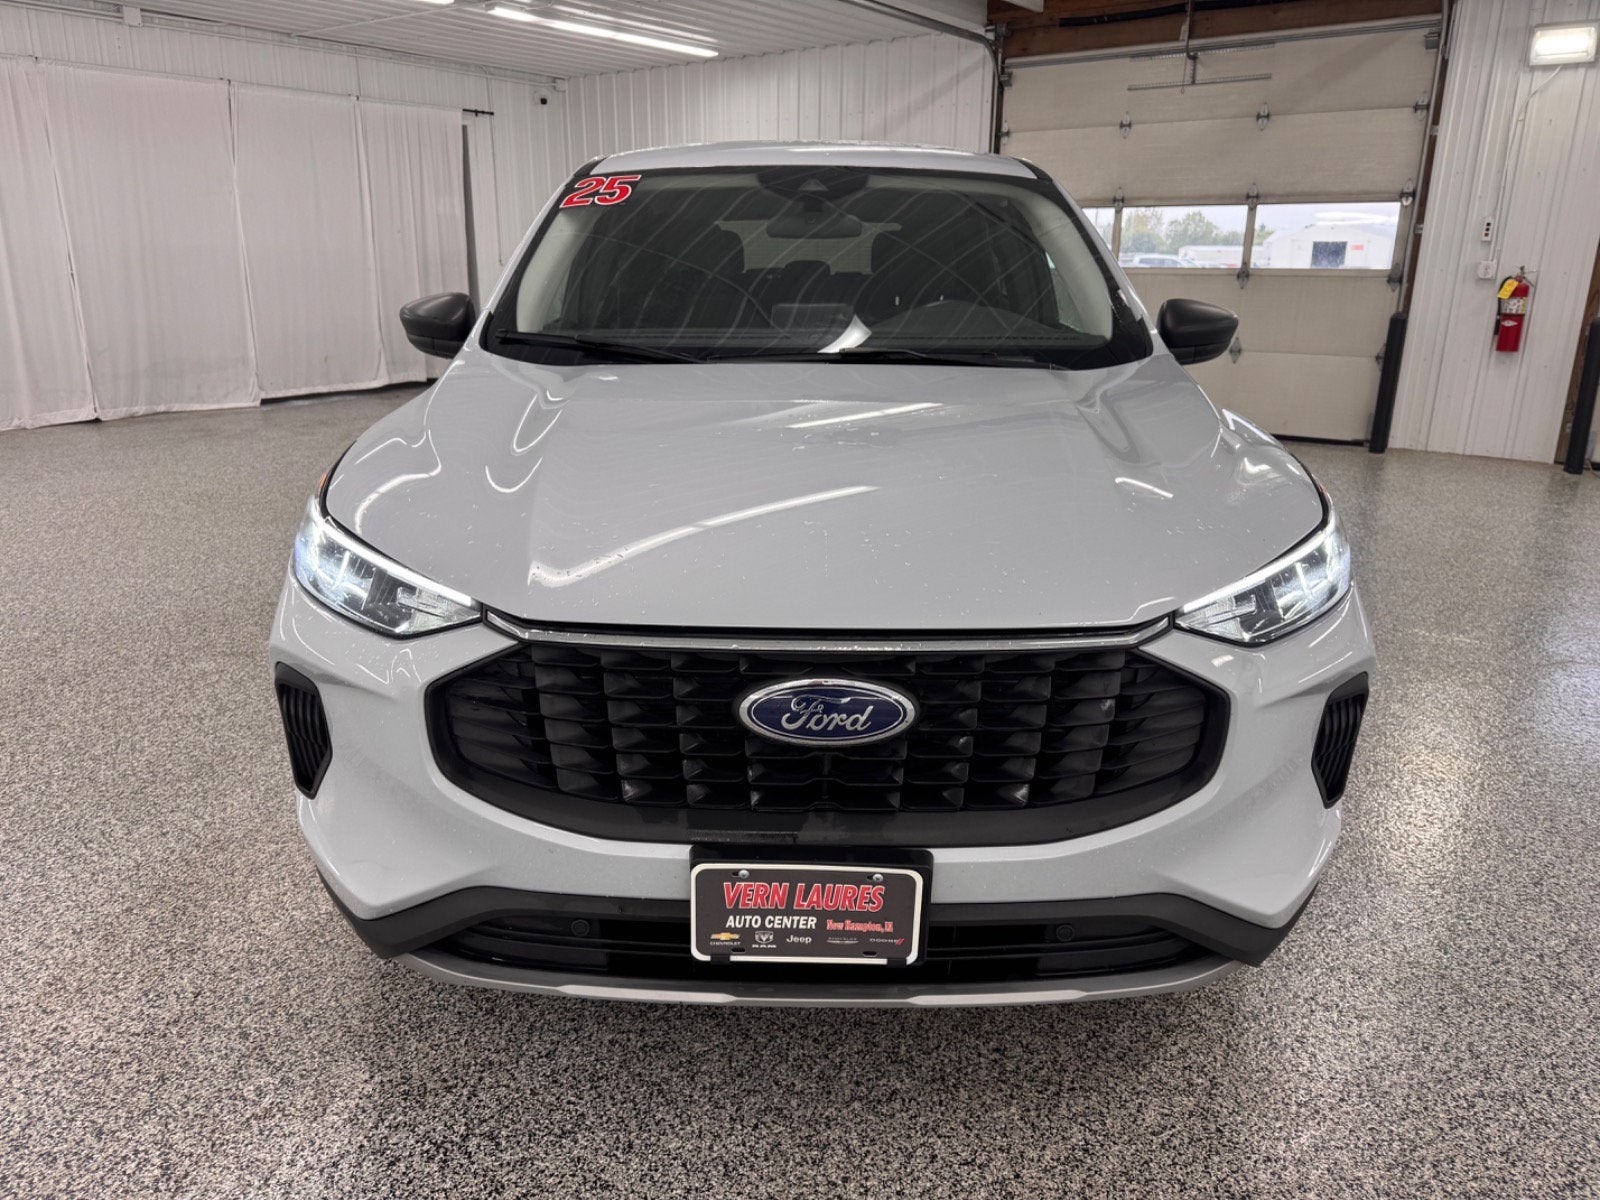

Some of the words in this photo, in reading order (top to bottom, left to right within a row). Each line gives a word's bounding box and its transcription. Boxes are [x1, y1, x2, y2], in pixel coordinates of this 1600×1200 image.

[559, 174, 642, 208] 25
[781, 694, 874, 731] Ford
[723, 882, 789, 910] VERN
[793, 883, 885, 912] LAURES
[725, 915, 762, 929] AUTO
[764, 915, 817, 930] CENTER
[826, 919, 844, 930] New
[786, 934, 812, 944] Jeep
